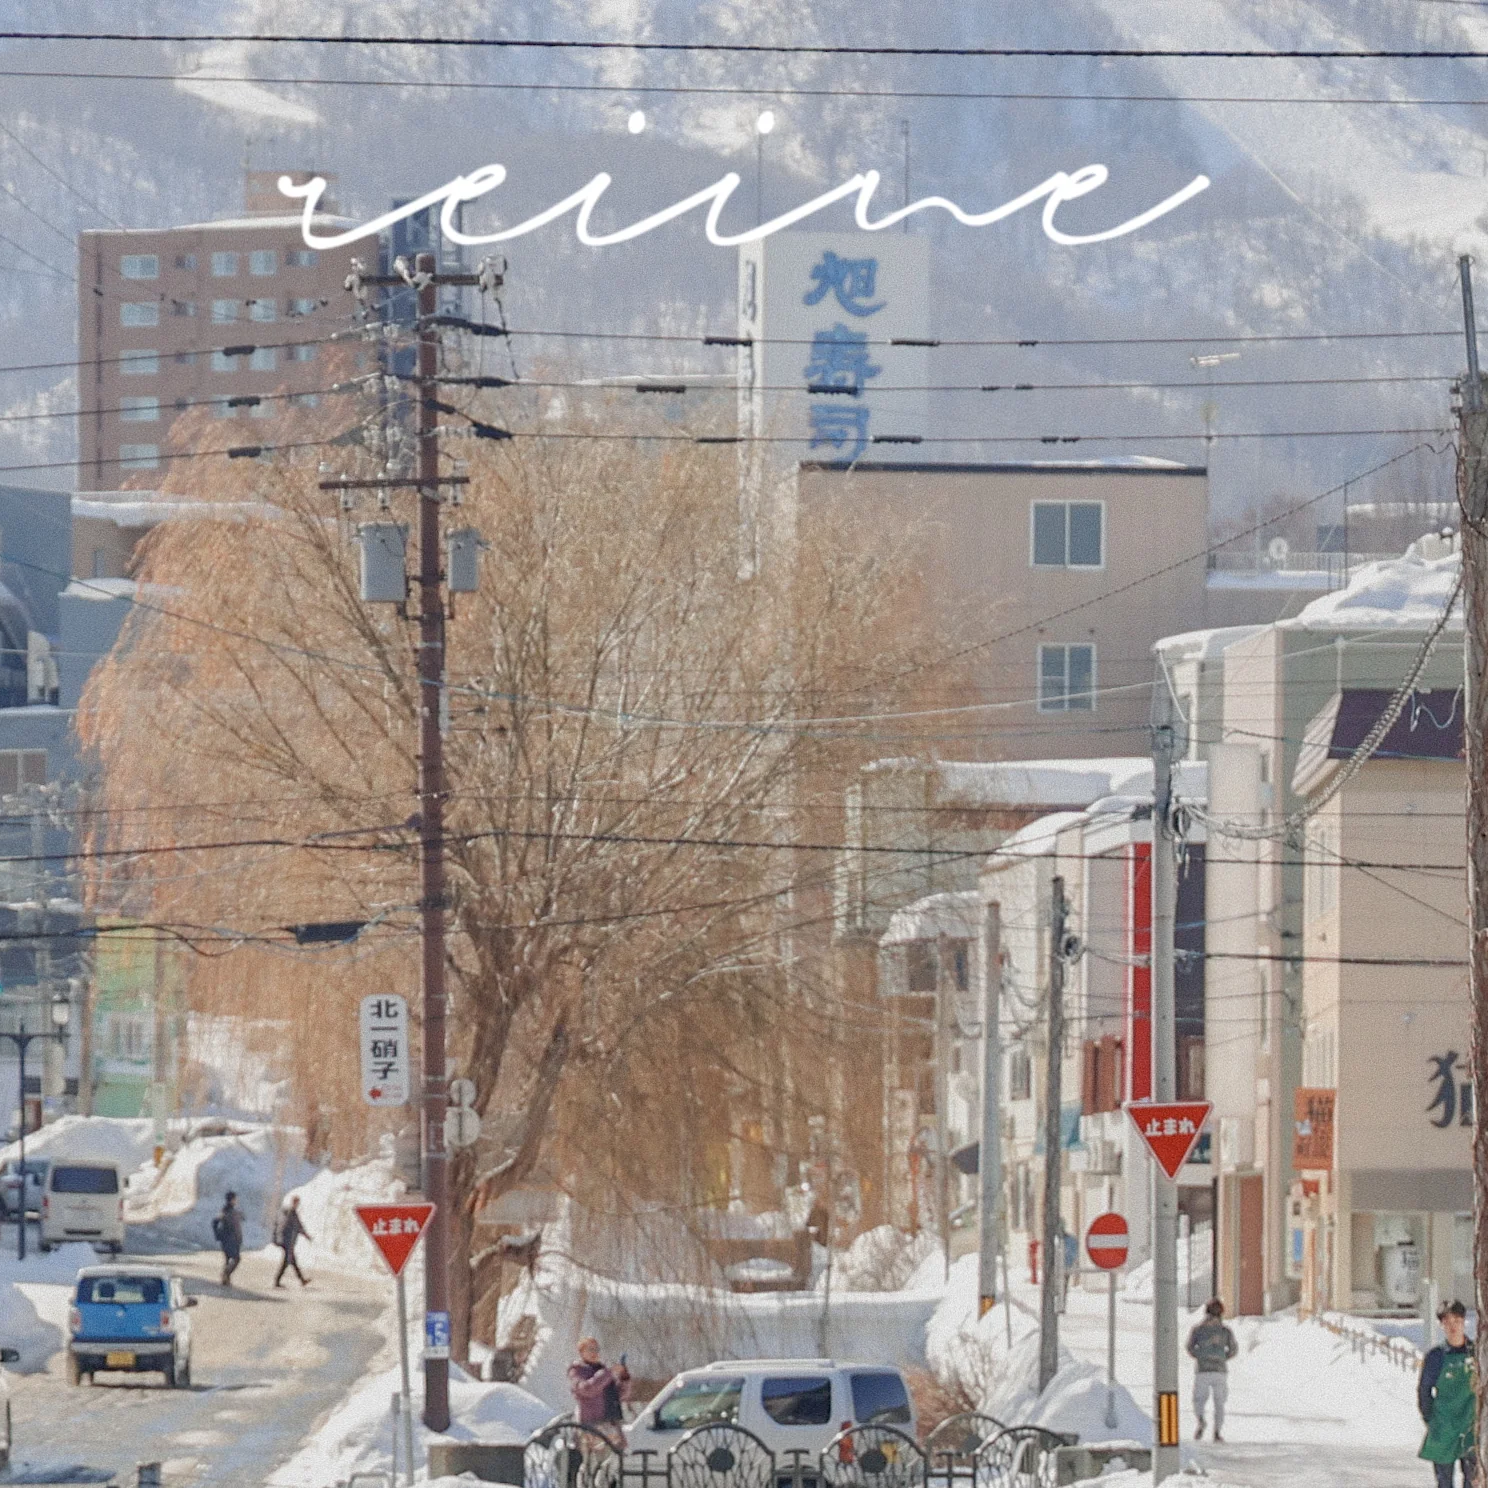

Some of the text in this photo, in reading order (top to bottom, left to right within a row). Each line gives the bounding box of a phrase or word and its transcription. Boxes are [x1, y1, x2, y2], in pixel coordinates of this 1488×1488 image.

[802, 249, 888, 462] 旭寿司
[369, 999, 400, 1081] 北一硝子
[1144, 1117, 1196, 1137] 止まれ
[372, 1217, 420, 1236] 止まれ
